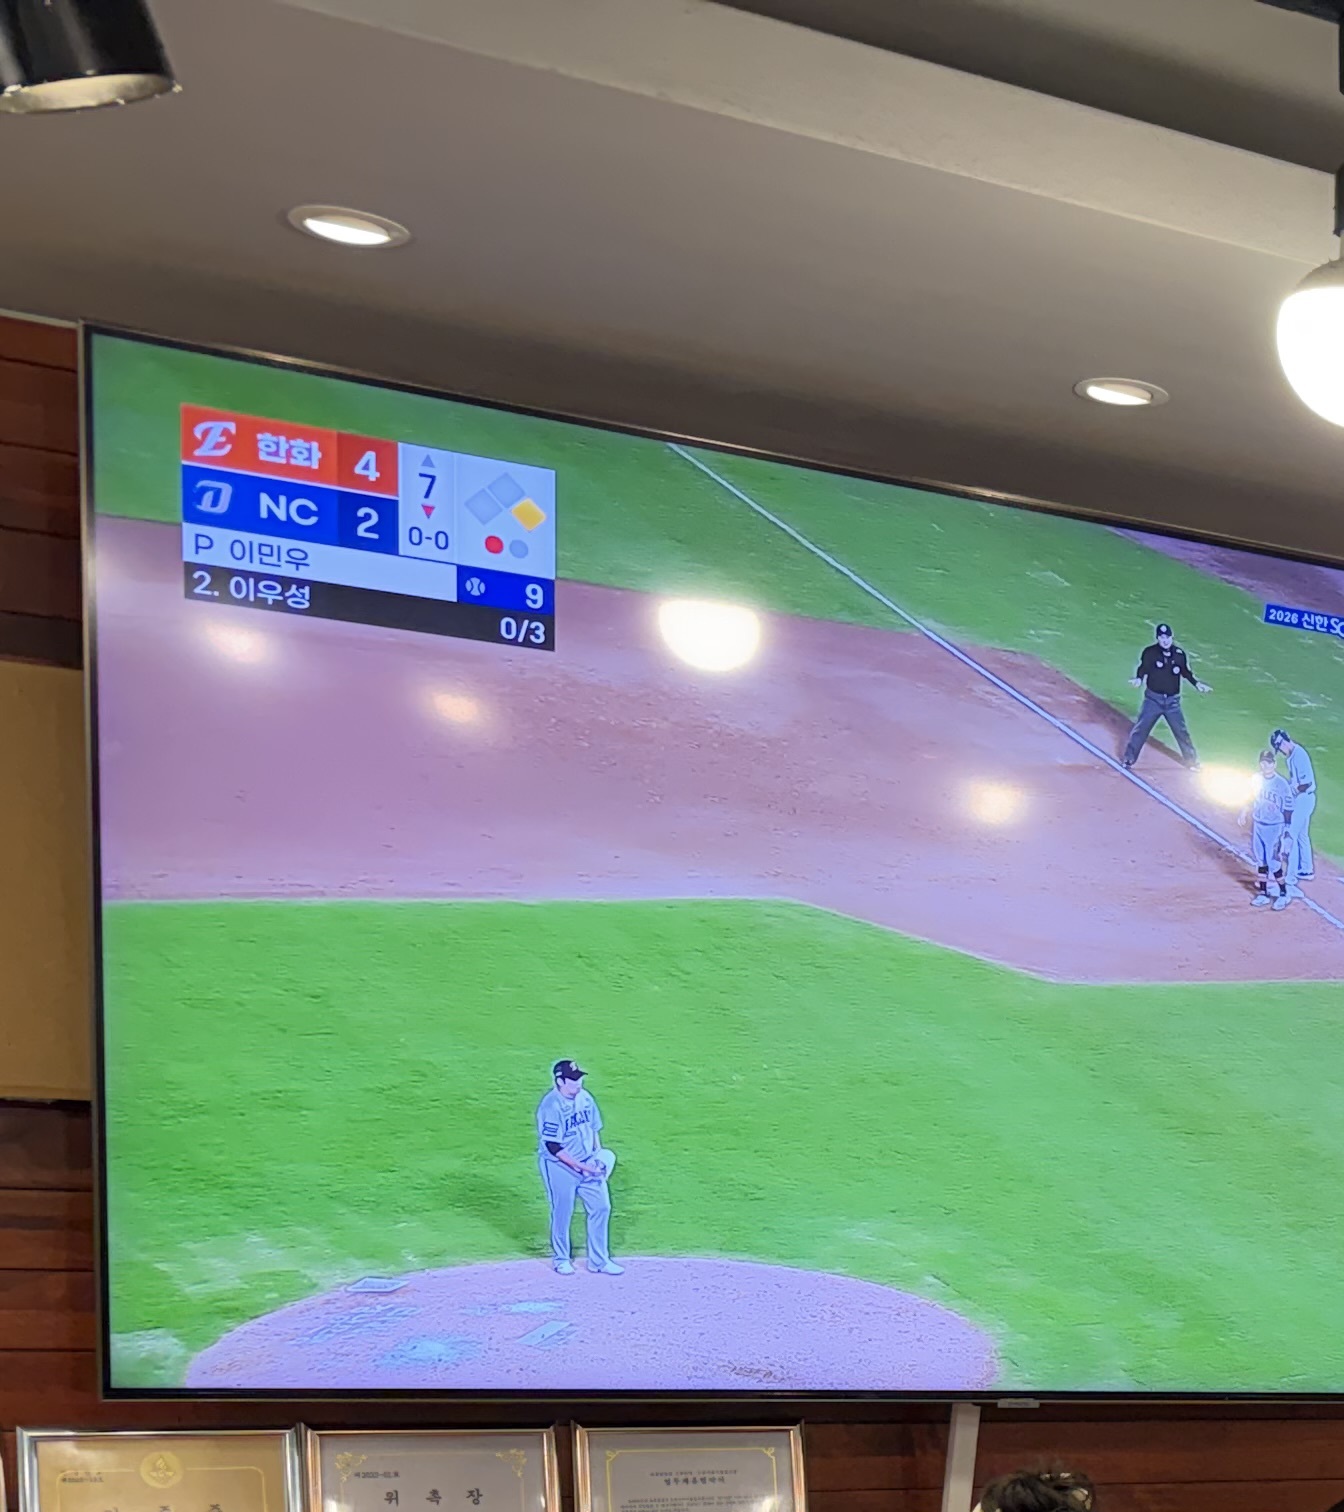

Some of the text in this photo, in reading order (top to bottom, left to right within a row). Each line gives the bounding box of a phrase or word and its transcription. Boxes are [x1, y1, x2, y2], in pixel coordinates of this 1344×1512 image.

[257, 432, 322, 469] 한화
[354, 451, 381, 481] 4
[418, 472, 436, 499] 7
[260, 492, 319, 526] NC
[356, 506, 379, 539] 2
[408, 526, 449, 550] 0-0
[194, 533, 310, 571] P 이민우
[192, 570, 311, 610] 2. 이우성
[525, 583, 544, 609] 9
[500, 617, 546, 644] 0/3
[1269, 608, 1299, 625] 2026
[1301, 612, 1329, 633] 신한
